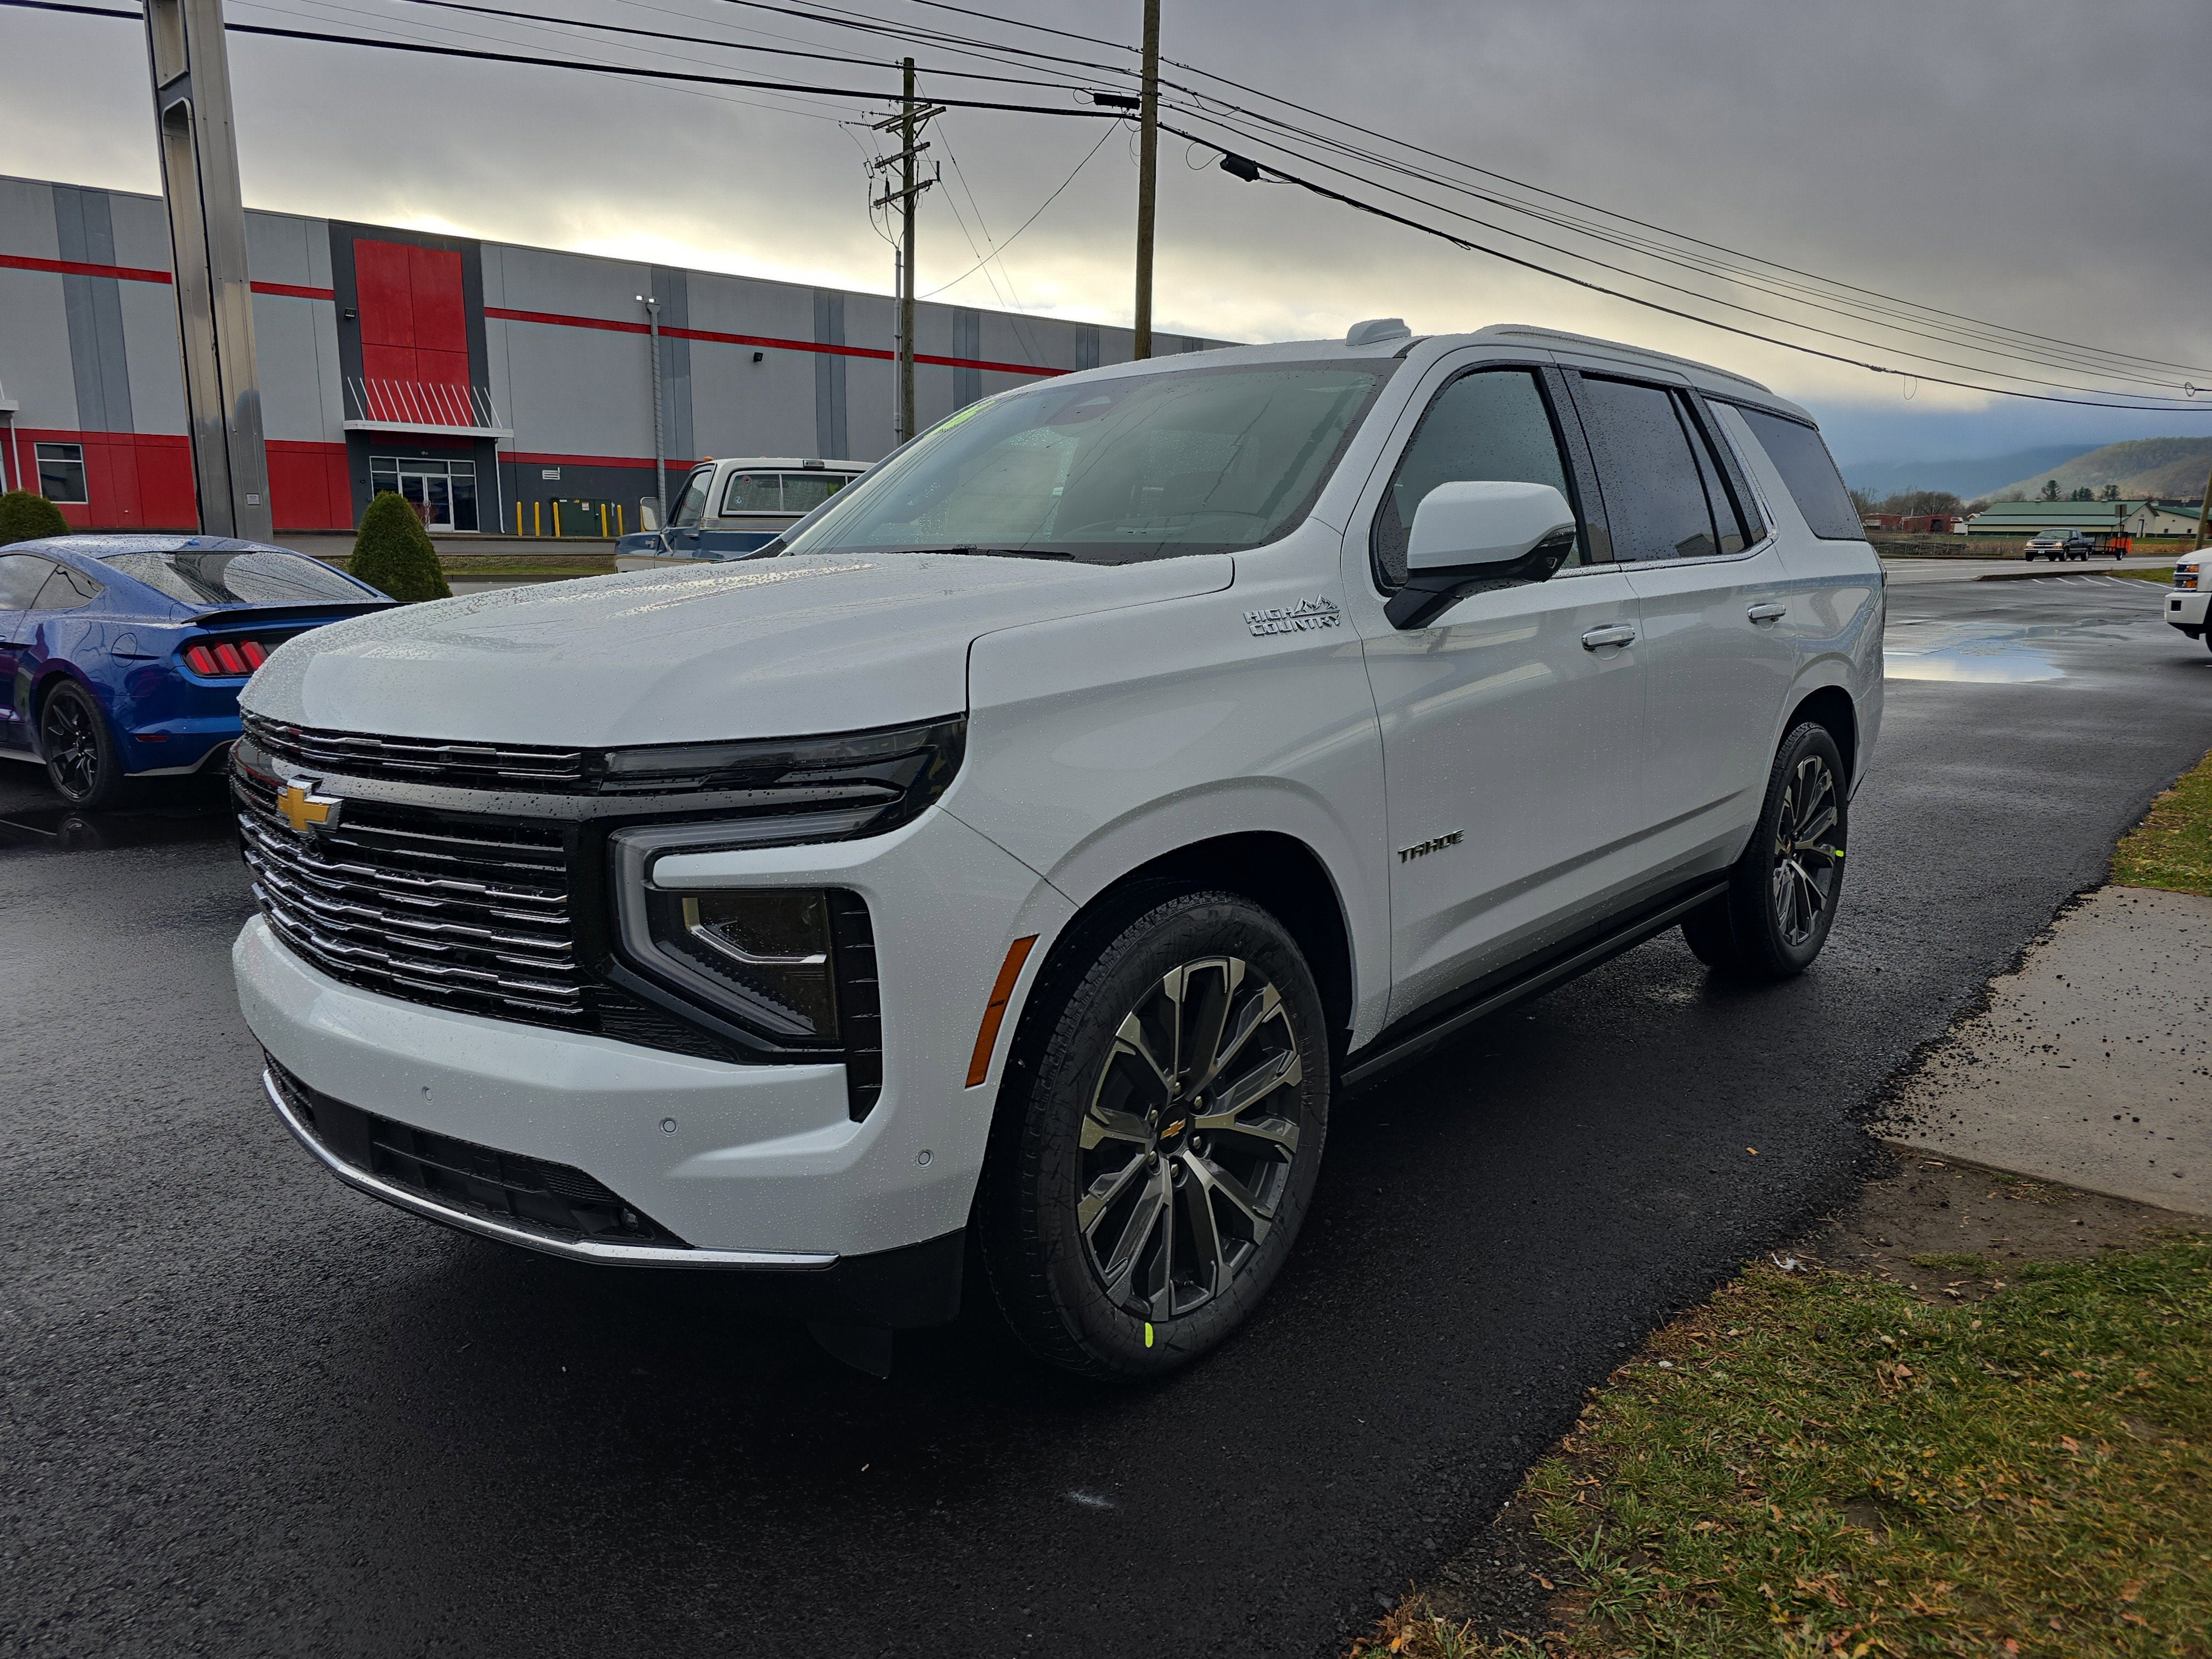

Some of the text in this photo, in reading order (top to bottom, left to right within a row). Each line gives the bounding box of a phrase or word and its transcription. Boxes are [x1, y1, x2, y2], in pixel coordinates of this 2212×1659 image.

[1243, 607, 1295, 623] HIGH
[1249, 613, 1341, 636] COUNTRY
[1398, 828, 1464, 864] TAHOE
